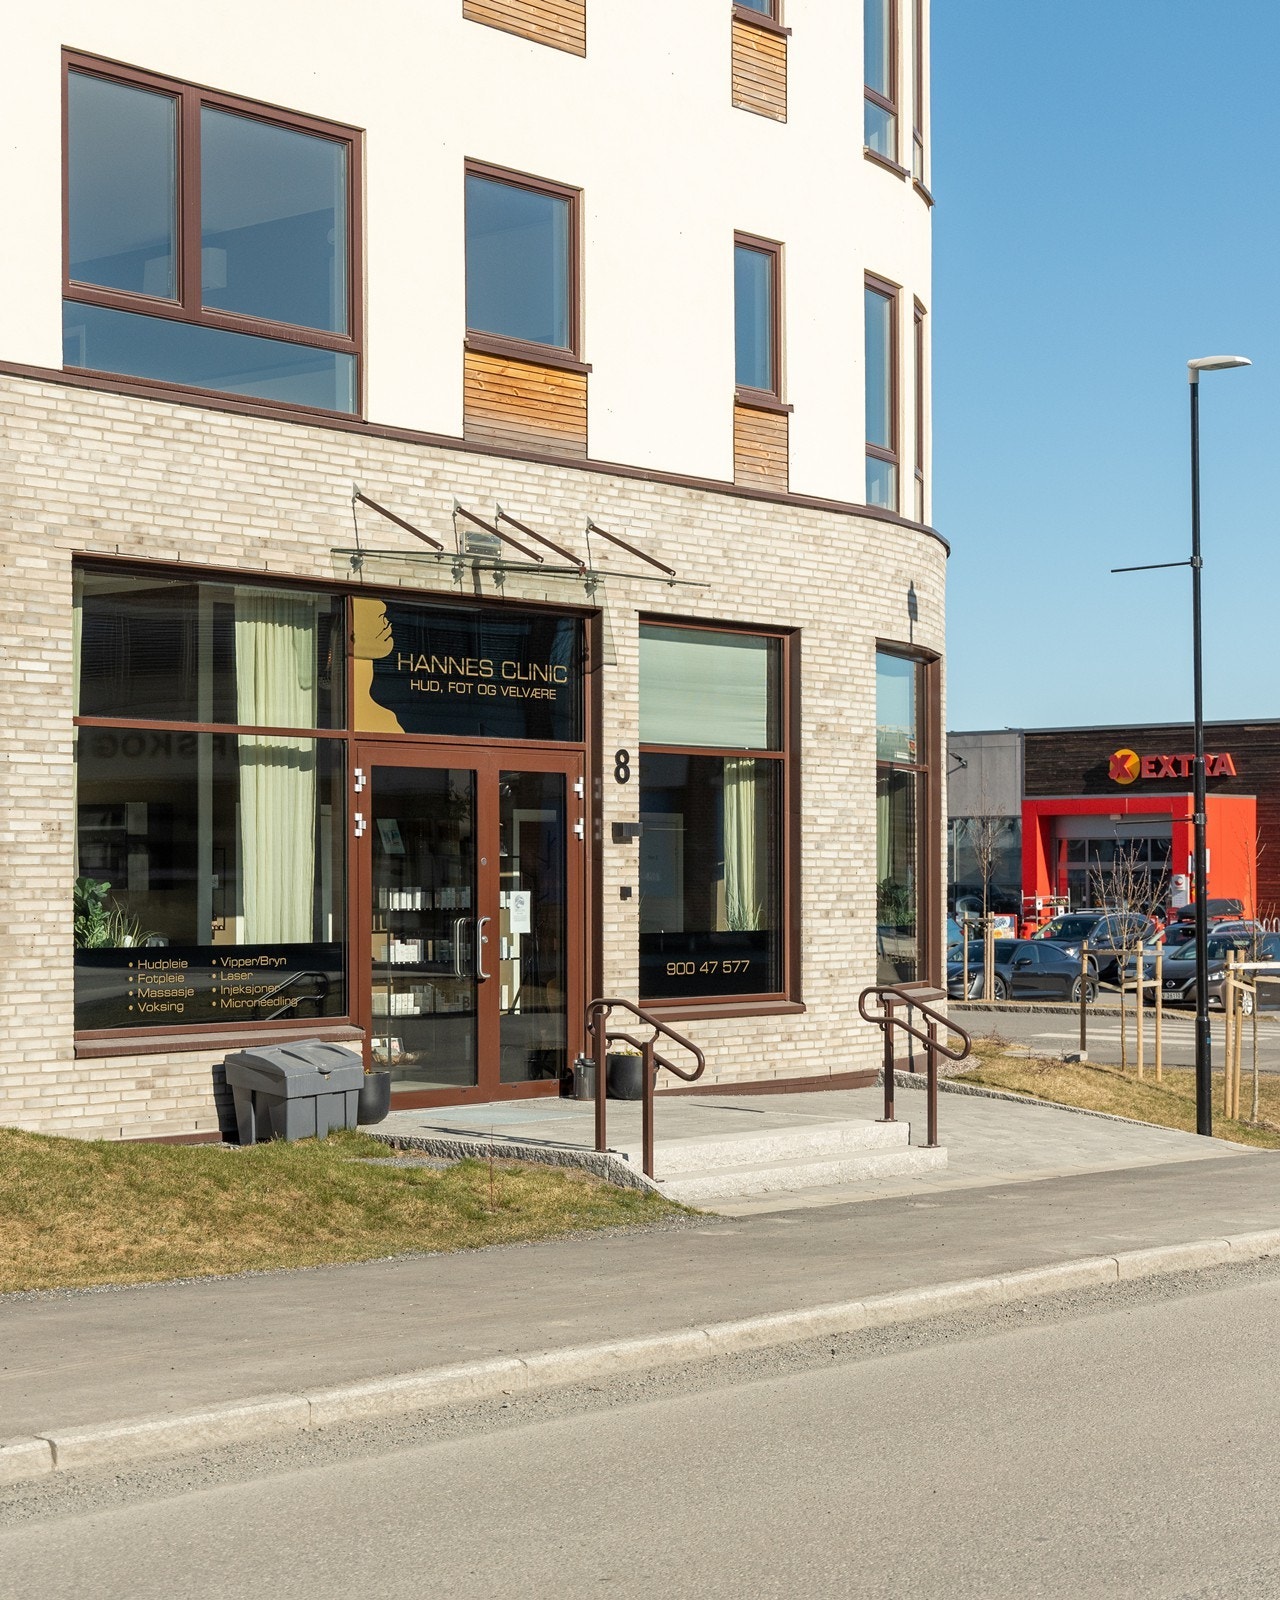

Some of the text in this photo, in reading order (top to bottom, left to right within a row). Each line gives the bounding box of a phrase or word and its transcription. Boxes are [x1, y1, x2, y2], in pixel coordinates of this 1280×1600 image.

[397, 652, 568, 683] HANNES CLINIC
[410, 679, 557, 700] HUD, FOT OG VELVÆRE
[614, 748, 631, 785] 8
[137, 958, 189, 971] Hudpleie
[220, 955, 287, 969] Vipper/Bryn
[666, 959, 750, 976] 900 47 577
[137, 972, 185, 985] Fotpleie
[220, 971, 254, 981] Laser
[137, 986, 195, 999] Massasje
[220, 984, 281, 996] Injeksjoner
[137, 1001, 185, 1013] Voksing
[220, 996, 298, 1009] Microneedling
